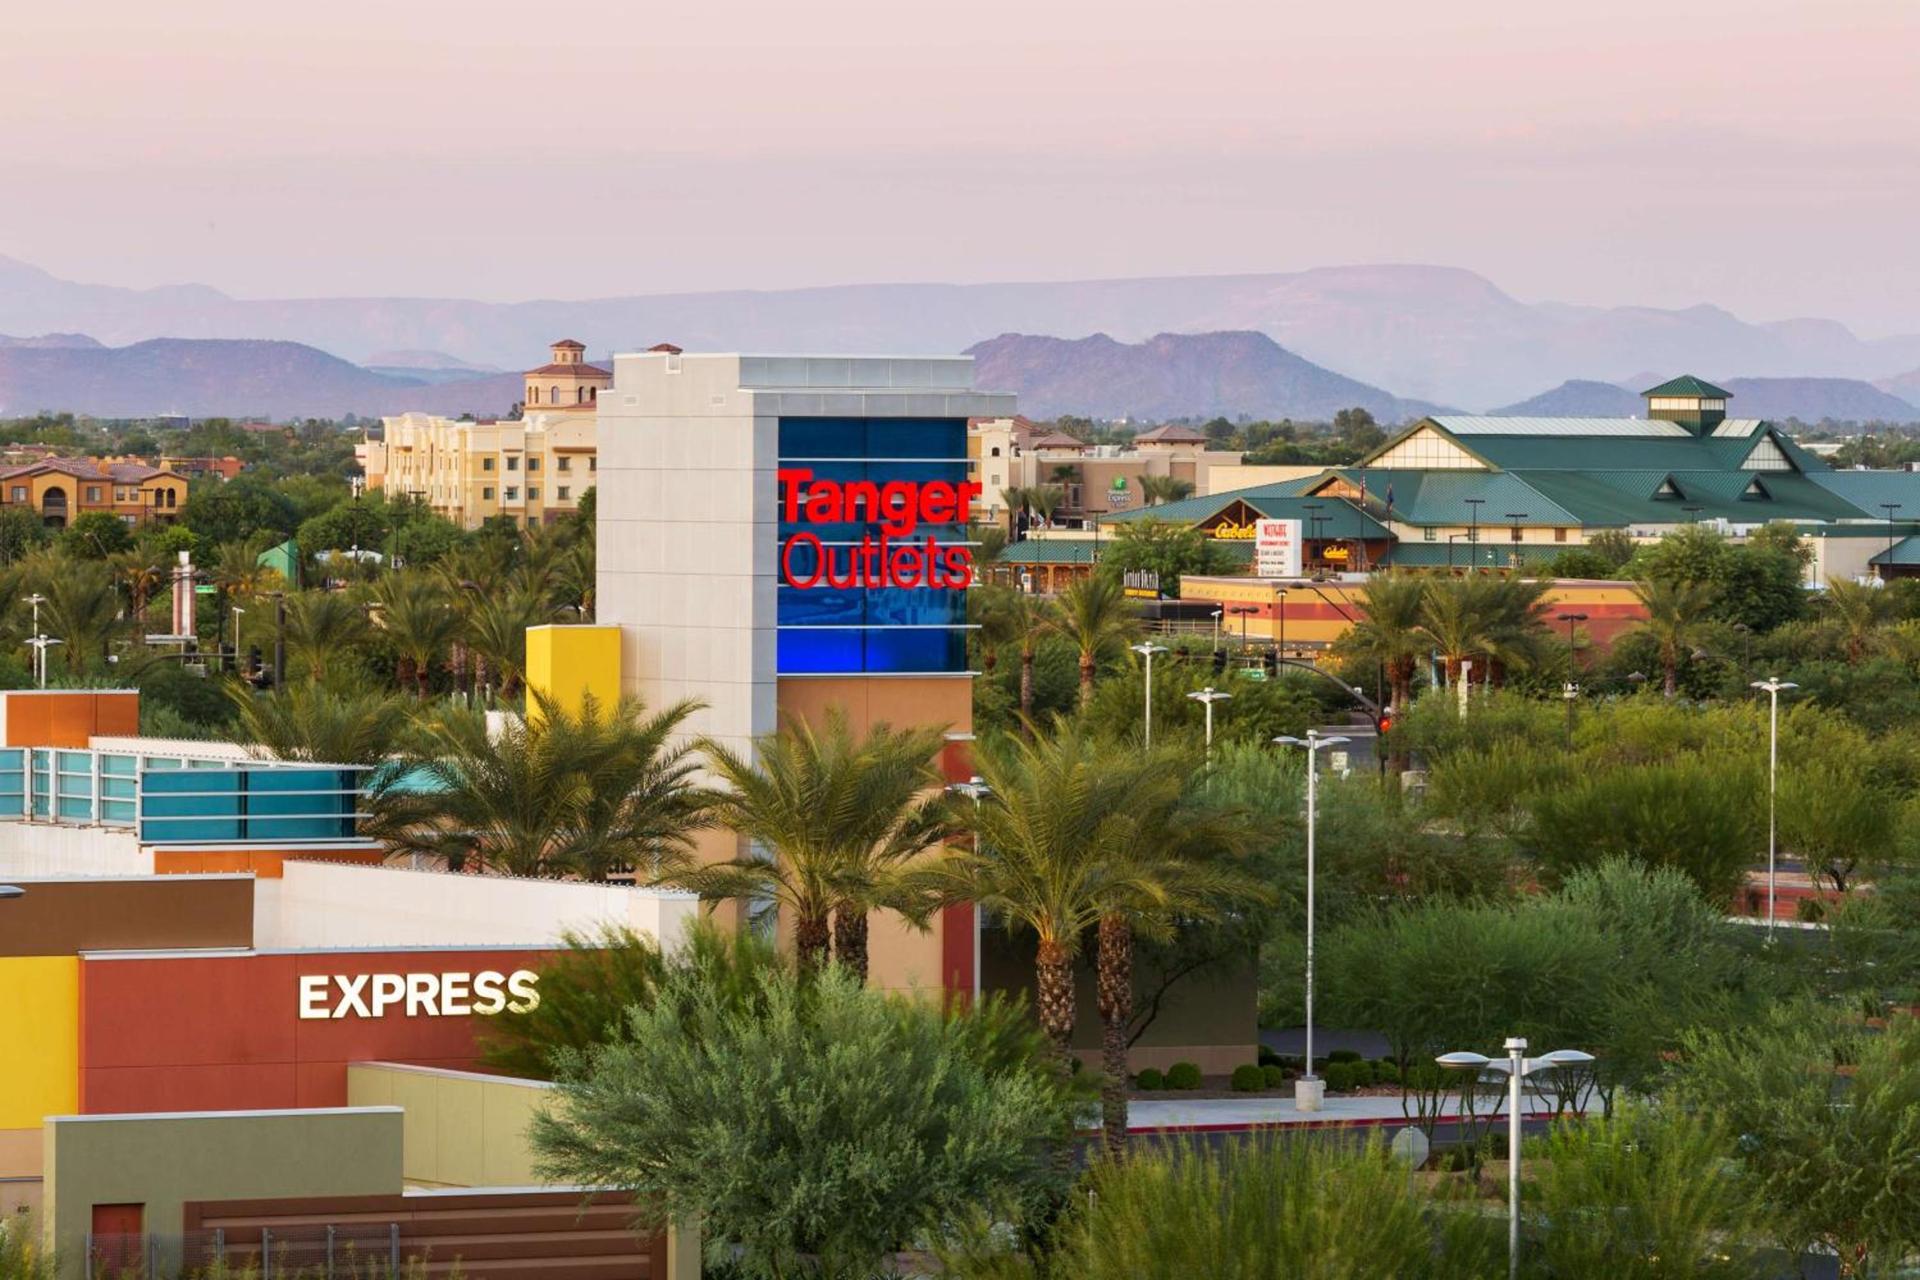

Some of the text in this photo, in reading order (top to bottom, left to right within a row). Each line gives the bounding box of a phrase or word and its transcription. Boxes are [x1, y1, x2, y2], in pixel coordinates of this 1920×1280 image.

[777, 468, 982, 537] Tanger
[782, 531, 973, 590] Outlets
[299, 970, 540, 1019] EXPRESS
